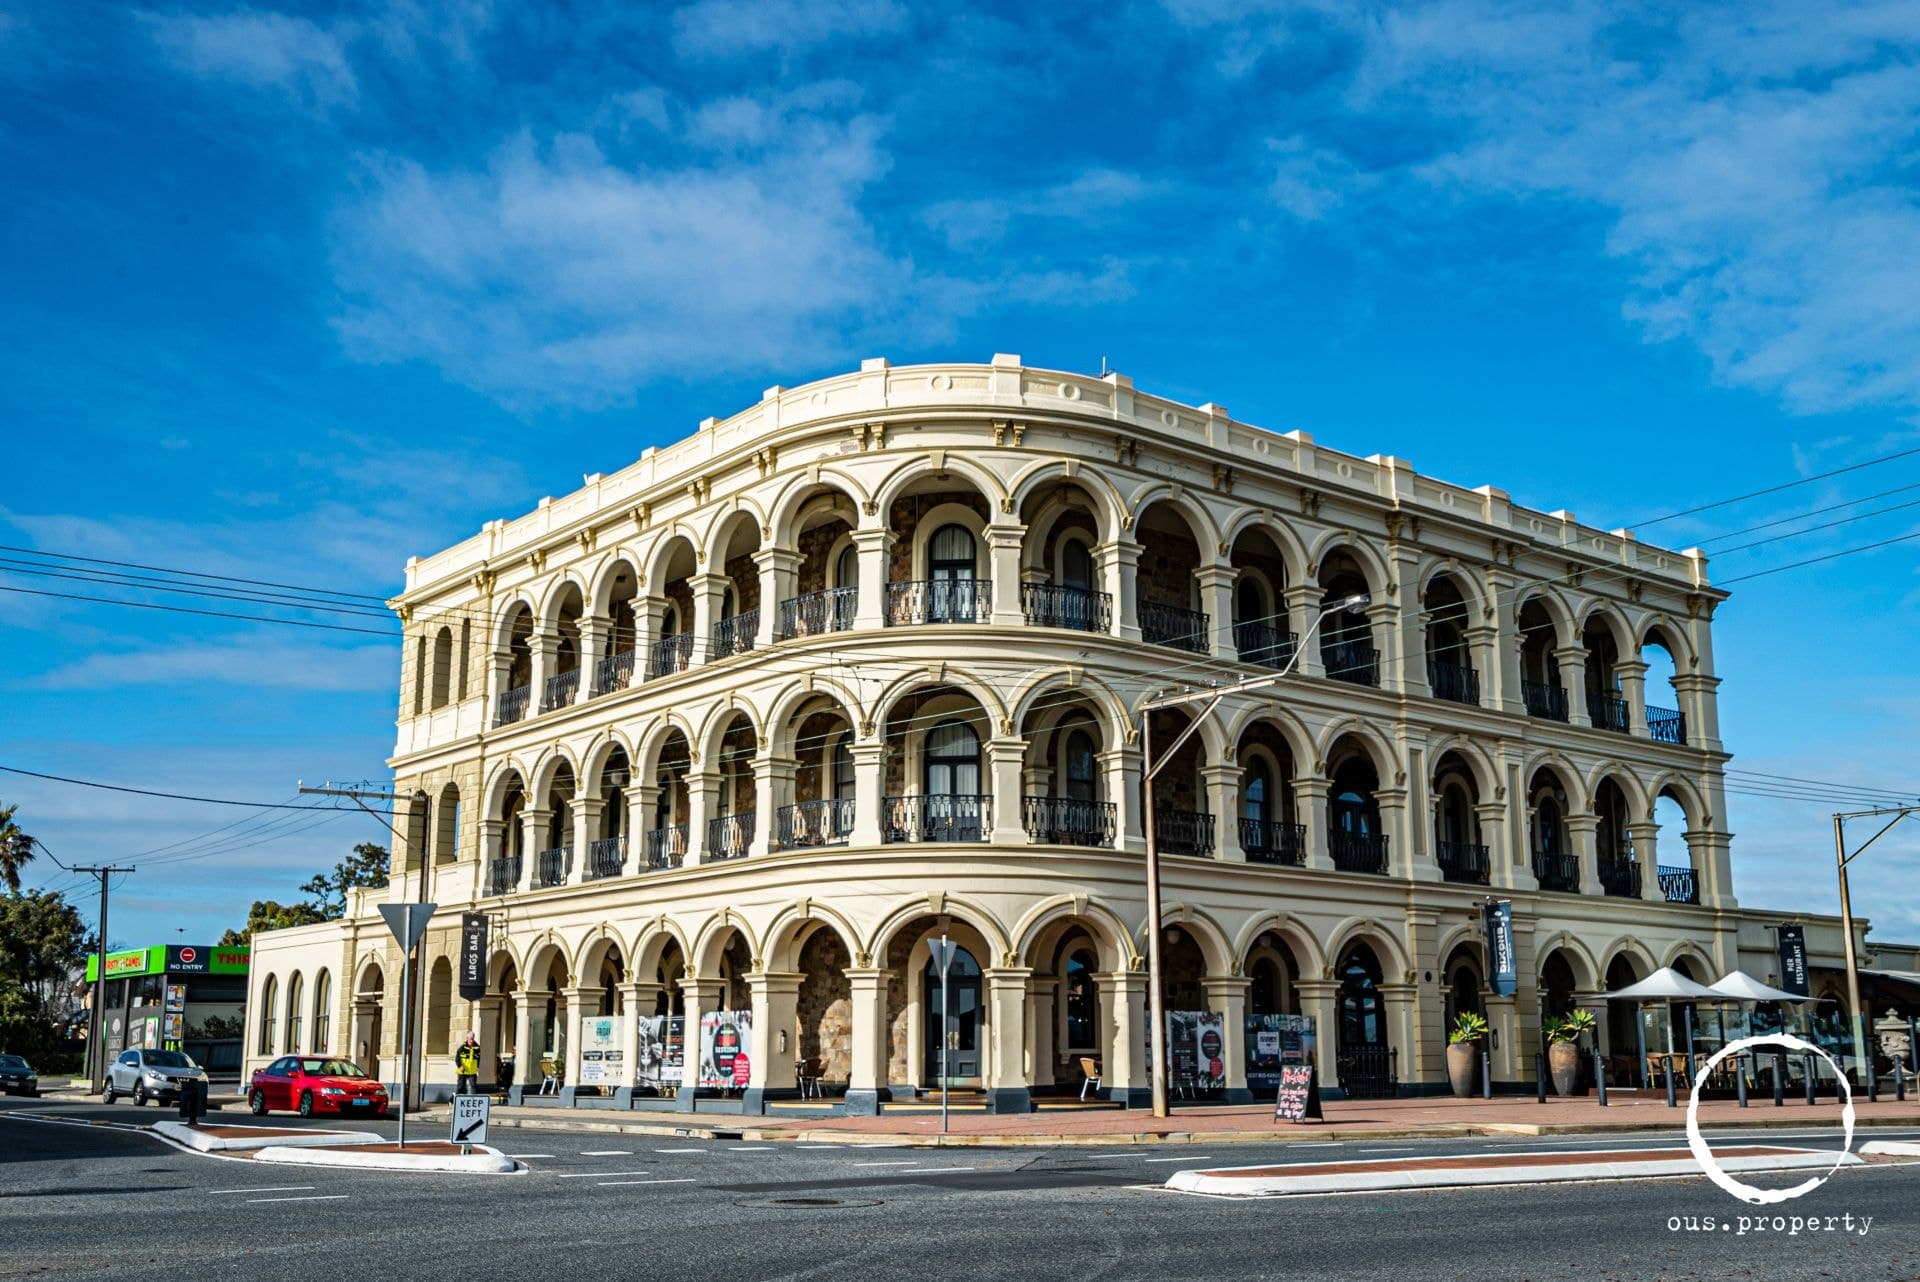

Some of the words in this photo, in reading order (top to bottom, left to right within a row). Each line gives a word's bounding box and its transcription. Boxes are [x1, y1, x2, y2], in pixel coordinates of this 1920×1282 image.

[469, 934, 479, 951] BAR
[182, 963, 203, 971] ENTRY
[468, 953, 478, 980] LARGS
[1786, 958, 1795, 972] PIER
[1793, 945, 1804, 985] RESTAURANT
[460, 1099, 484, 1108] KEEP
[460, 1109, 482, 1118] LEFT
